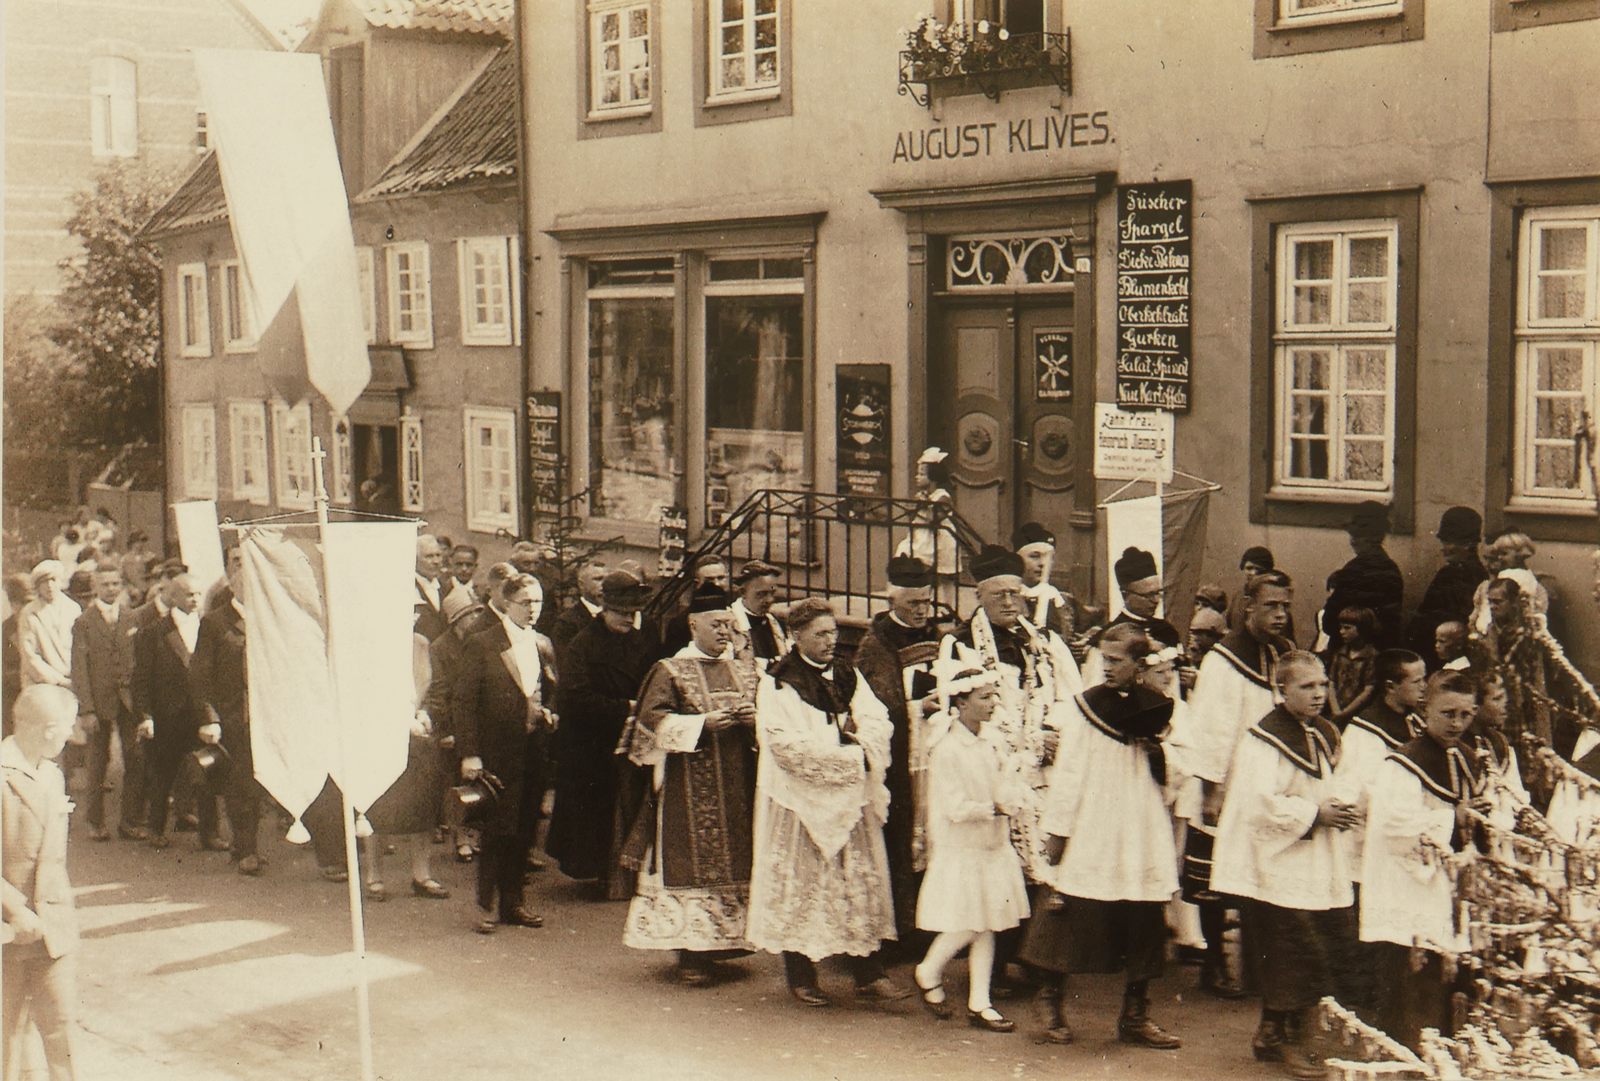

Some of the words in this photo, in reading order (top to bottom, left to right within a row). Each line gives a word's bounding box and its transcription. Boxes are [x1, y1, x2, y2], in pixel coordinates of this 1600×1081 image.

[892, 122, 998, 164] AUGUST
[1127, 189, 1188, 211] Frischer
[1119, 212, 1184, 242] Spargel
[1118, 247, 1154, 269] Dicke
[1118, 275, 1190, 297] Blumenkohl
[1122, 327, 1179, 350] Gurken
